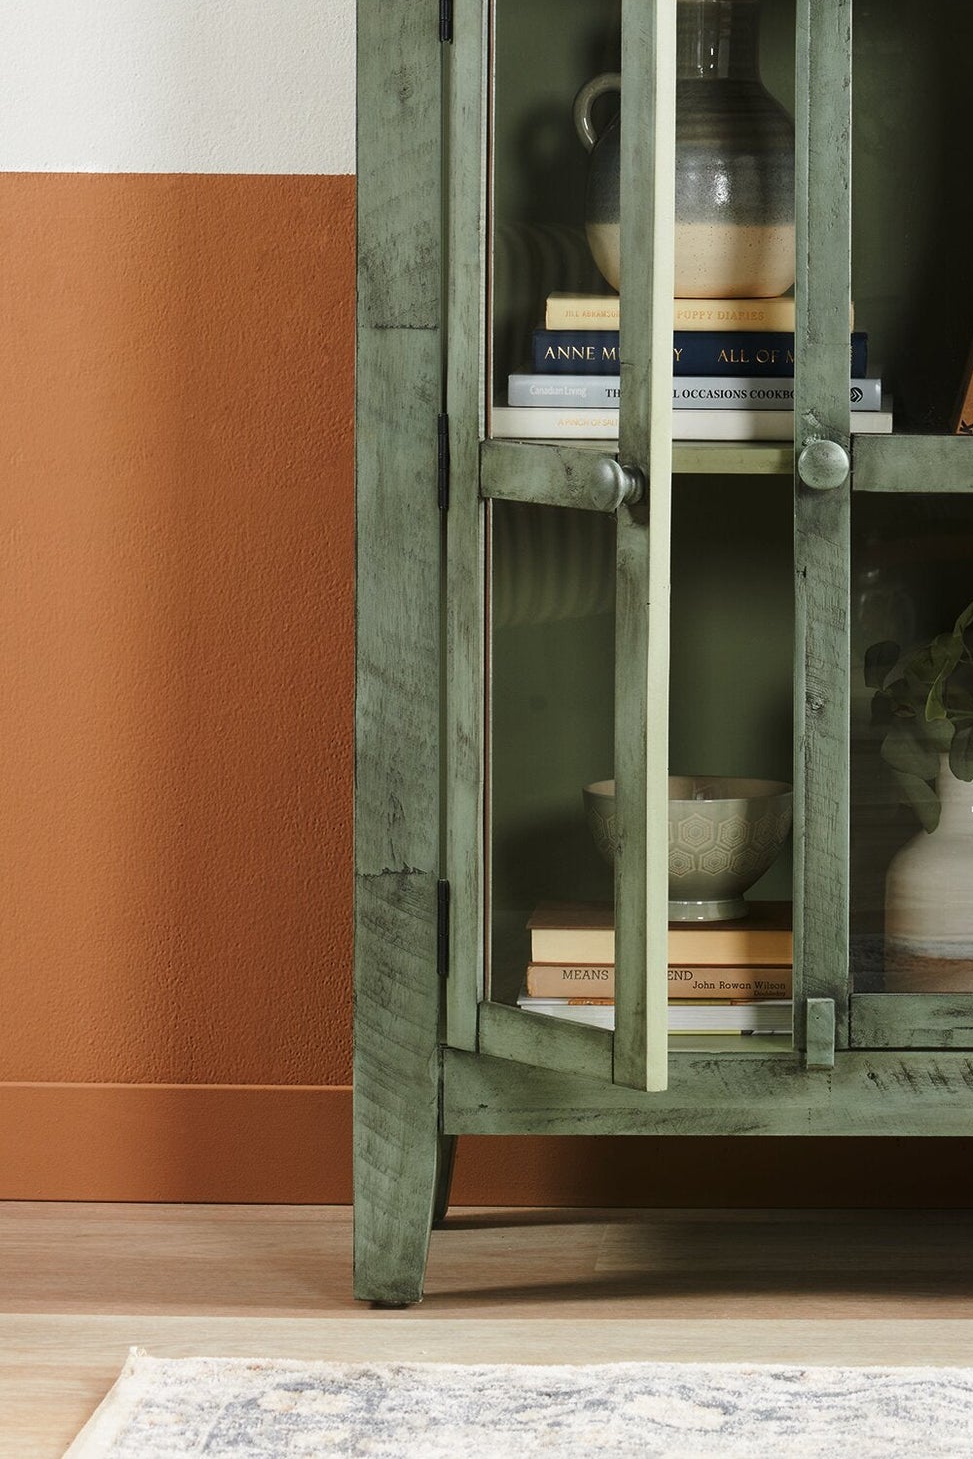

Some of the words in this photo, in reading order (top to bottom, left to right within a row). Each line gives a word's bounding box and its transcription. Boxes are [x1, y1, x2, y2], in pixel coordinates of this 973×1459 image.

[582, 310, 619, 318] ABRAMSO
[677, 310, 712, 320] PUPPY
[717, 311, 765, 320] DIARIES
[544, 346, 596, 360] ANNE
[717, 349, 750, 363] ALL
[756, 349, 780, 363] OF
[529, 384, 564, 397] Canadian
[564, 385, 588, 398] Living
[605, 388, 620, 399] TH
[682, 389, 747, 399] OCCASIONS
[562, 969, 609, 980] MEANS
[668, 970, 693, 981] END
[692, 980, 715, 990] John
[719, 981, 751, 990] Rowan
[754, 981, 786, 990] Wilson
